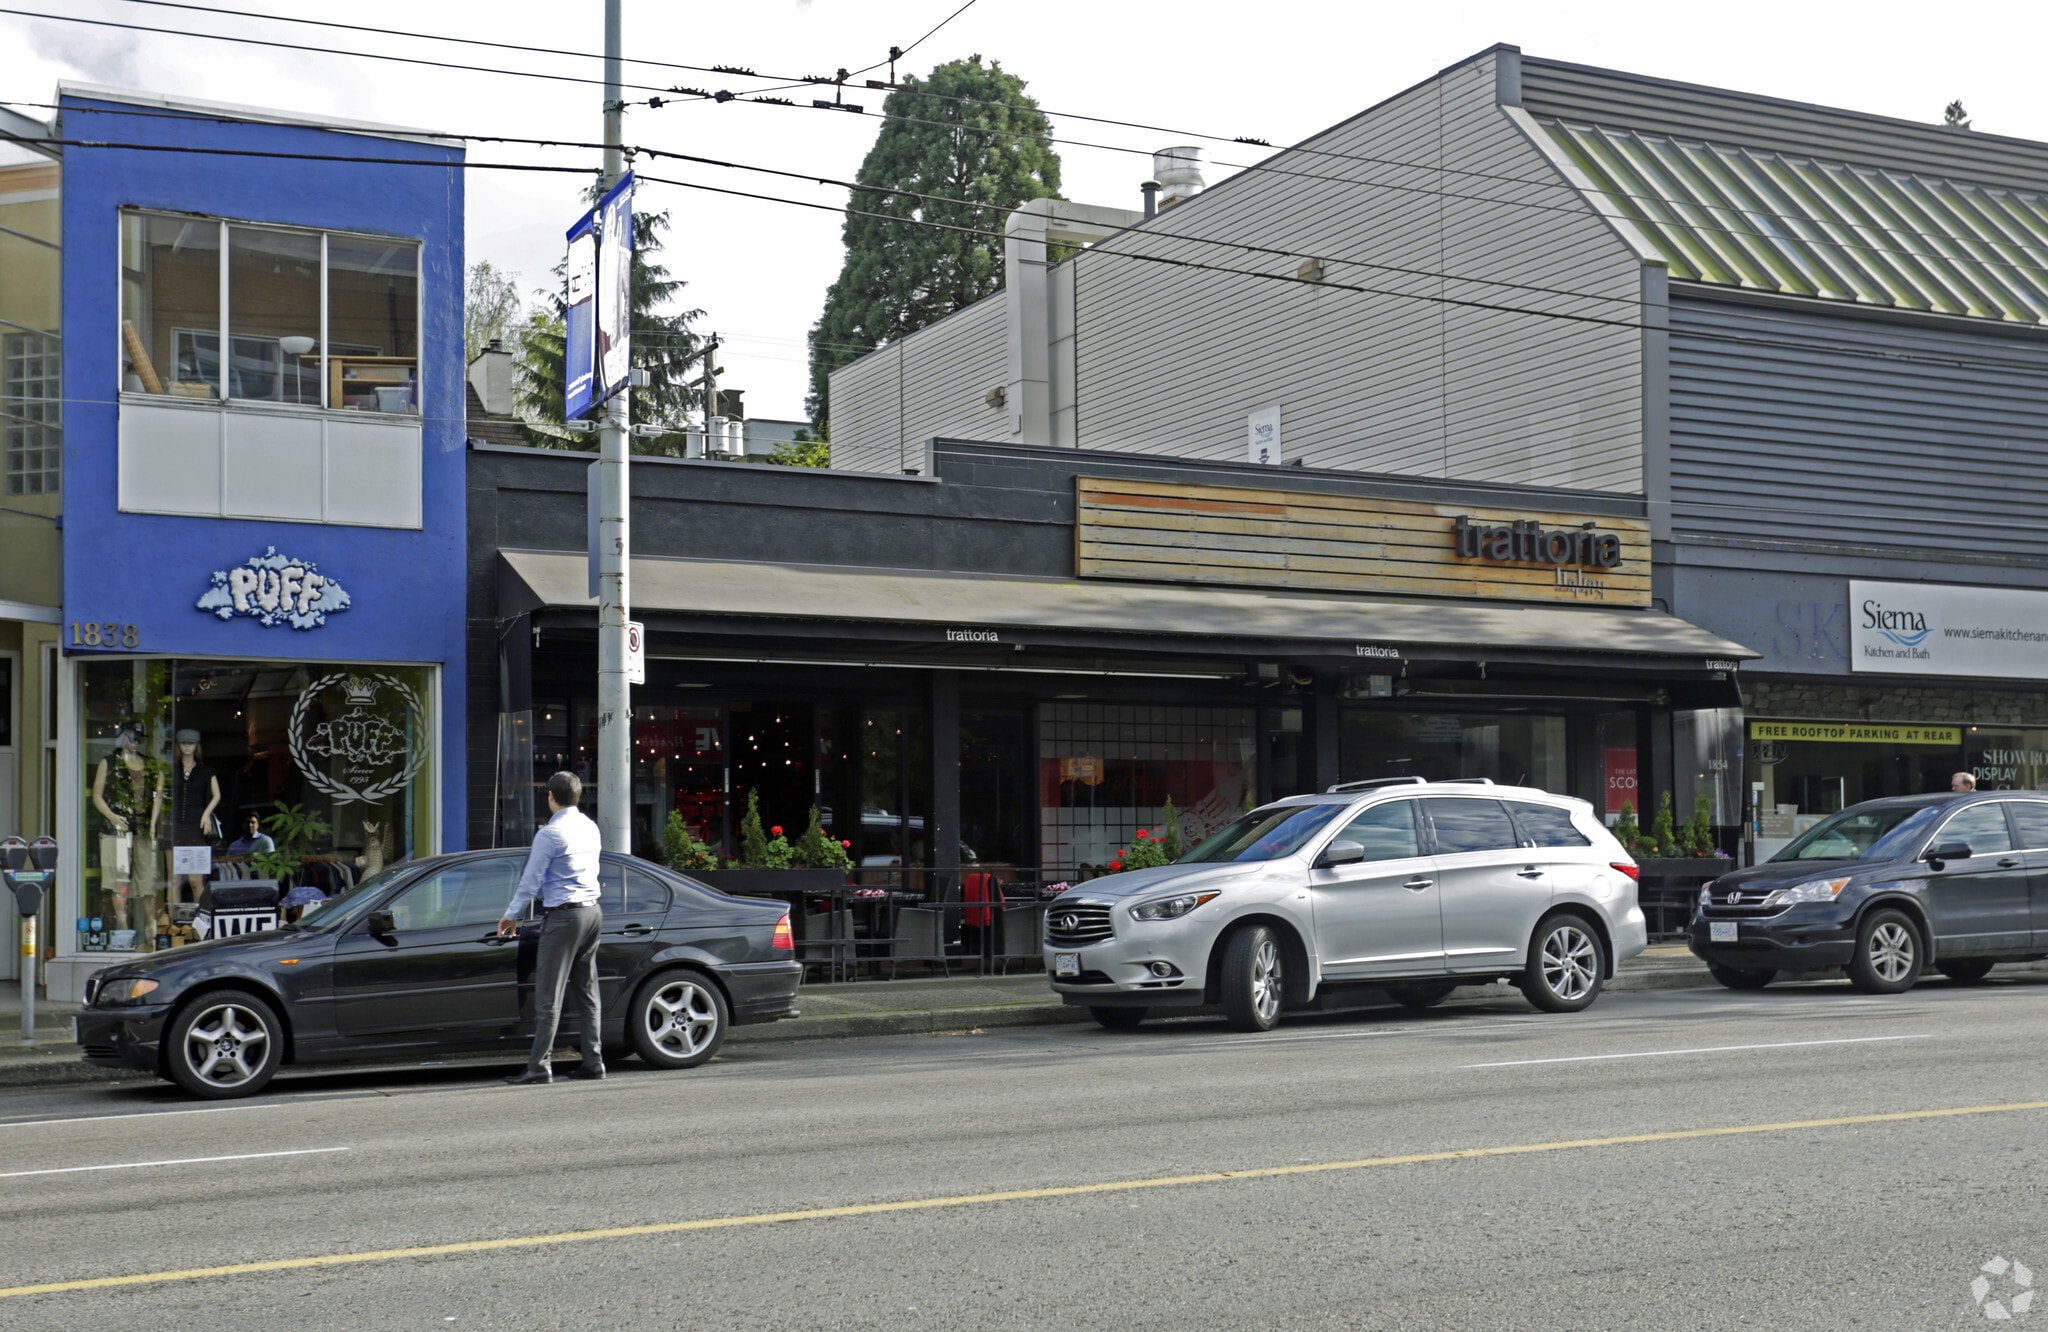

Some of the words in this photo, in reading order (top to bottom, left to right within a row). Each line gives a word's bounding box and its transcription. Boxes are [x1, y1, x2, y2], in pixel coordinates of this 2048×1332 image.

[1452, 514, 1622, 567] trattoria
[229, 566, 324, 615] PUFF
[1862, 599, 1928, 632] Siema
[70, 620, 140, 648] 1838
[946, 628, 999, 643] trattoria
[1944, 626, 2048, 643] www.siemakitchenan
[1356, 644, 1399, 659] trattoria
[1864, 645, 1894, 658] Kitchen
[1895, 647, 1911, 659] and
[1912, 648, 1930, 659] Bath
[328, 718, 395, 756] PUFF
[1758, 726, 1788, 737] FREE
[1792, 727, 1845, 738] ROOFTOP
[1850, 727, 1900, 740] PARKING
[1906, 730, 1919, 740] AT
[1924, 731, 1952, 741] REAR
[342, 765, 375, 775] Since
[1708, 759, 1729, 770] 1854
[1973, 766, 2018, 781] DISPLAY
[1609, 777, 1638, 789] SCO
